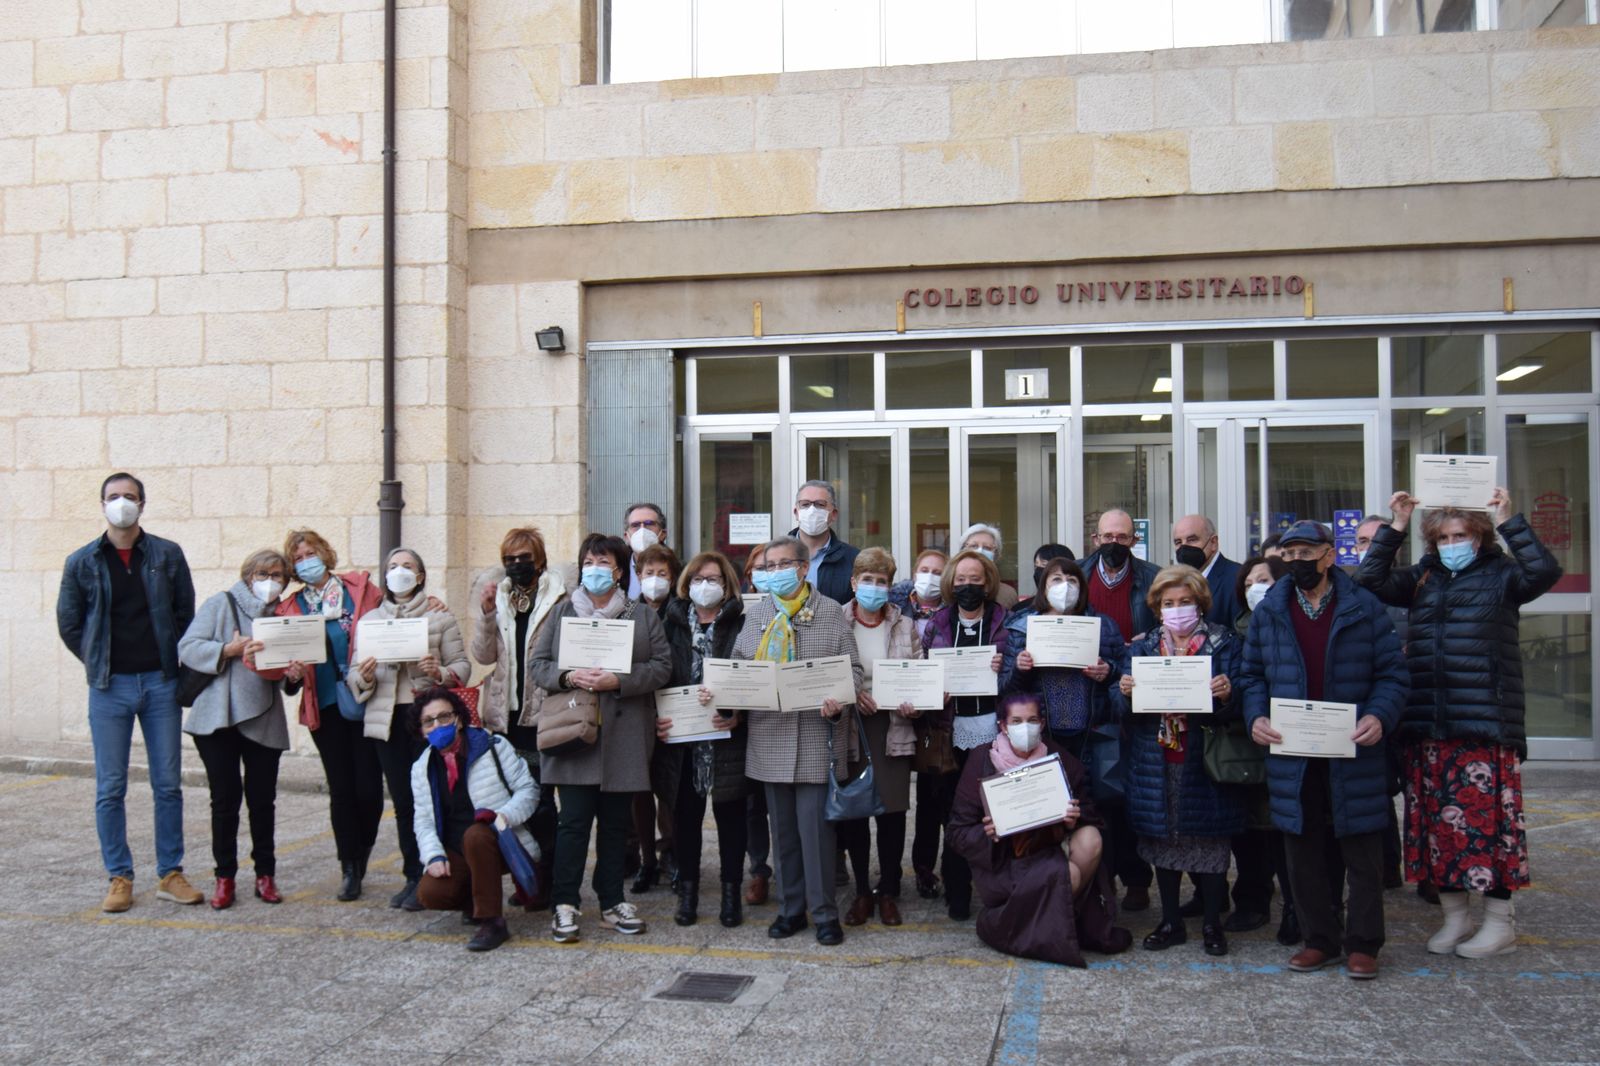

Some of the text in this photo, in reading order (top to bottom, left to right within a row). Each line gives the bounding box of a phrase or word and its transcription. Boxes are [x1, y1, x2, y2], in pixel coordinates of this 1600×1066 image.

[904, 275, 1305, 308] COLEGIO UNIVERSITARIO
[1022, 376, 1031, 396] 1
